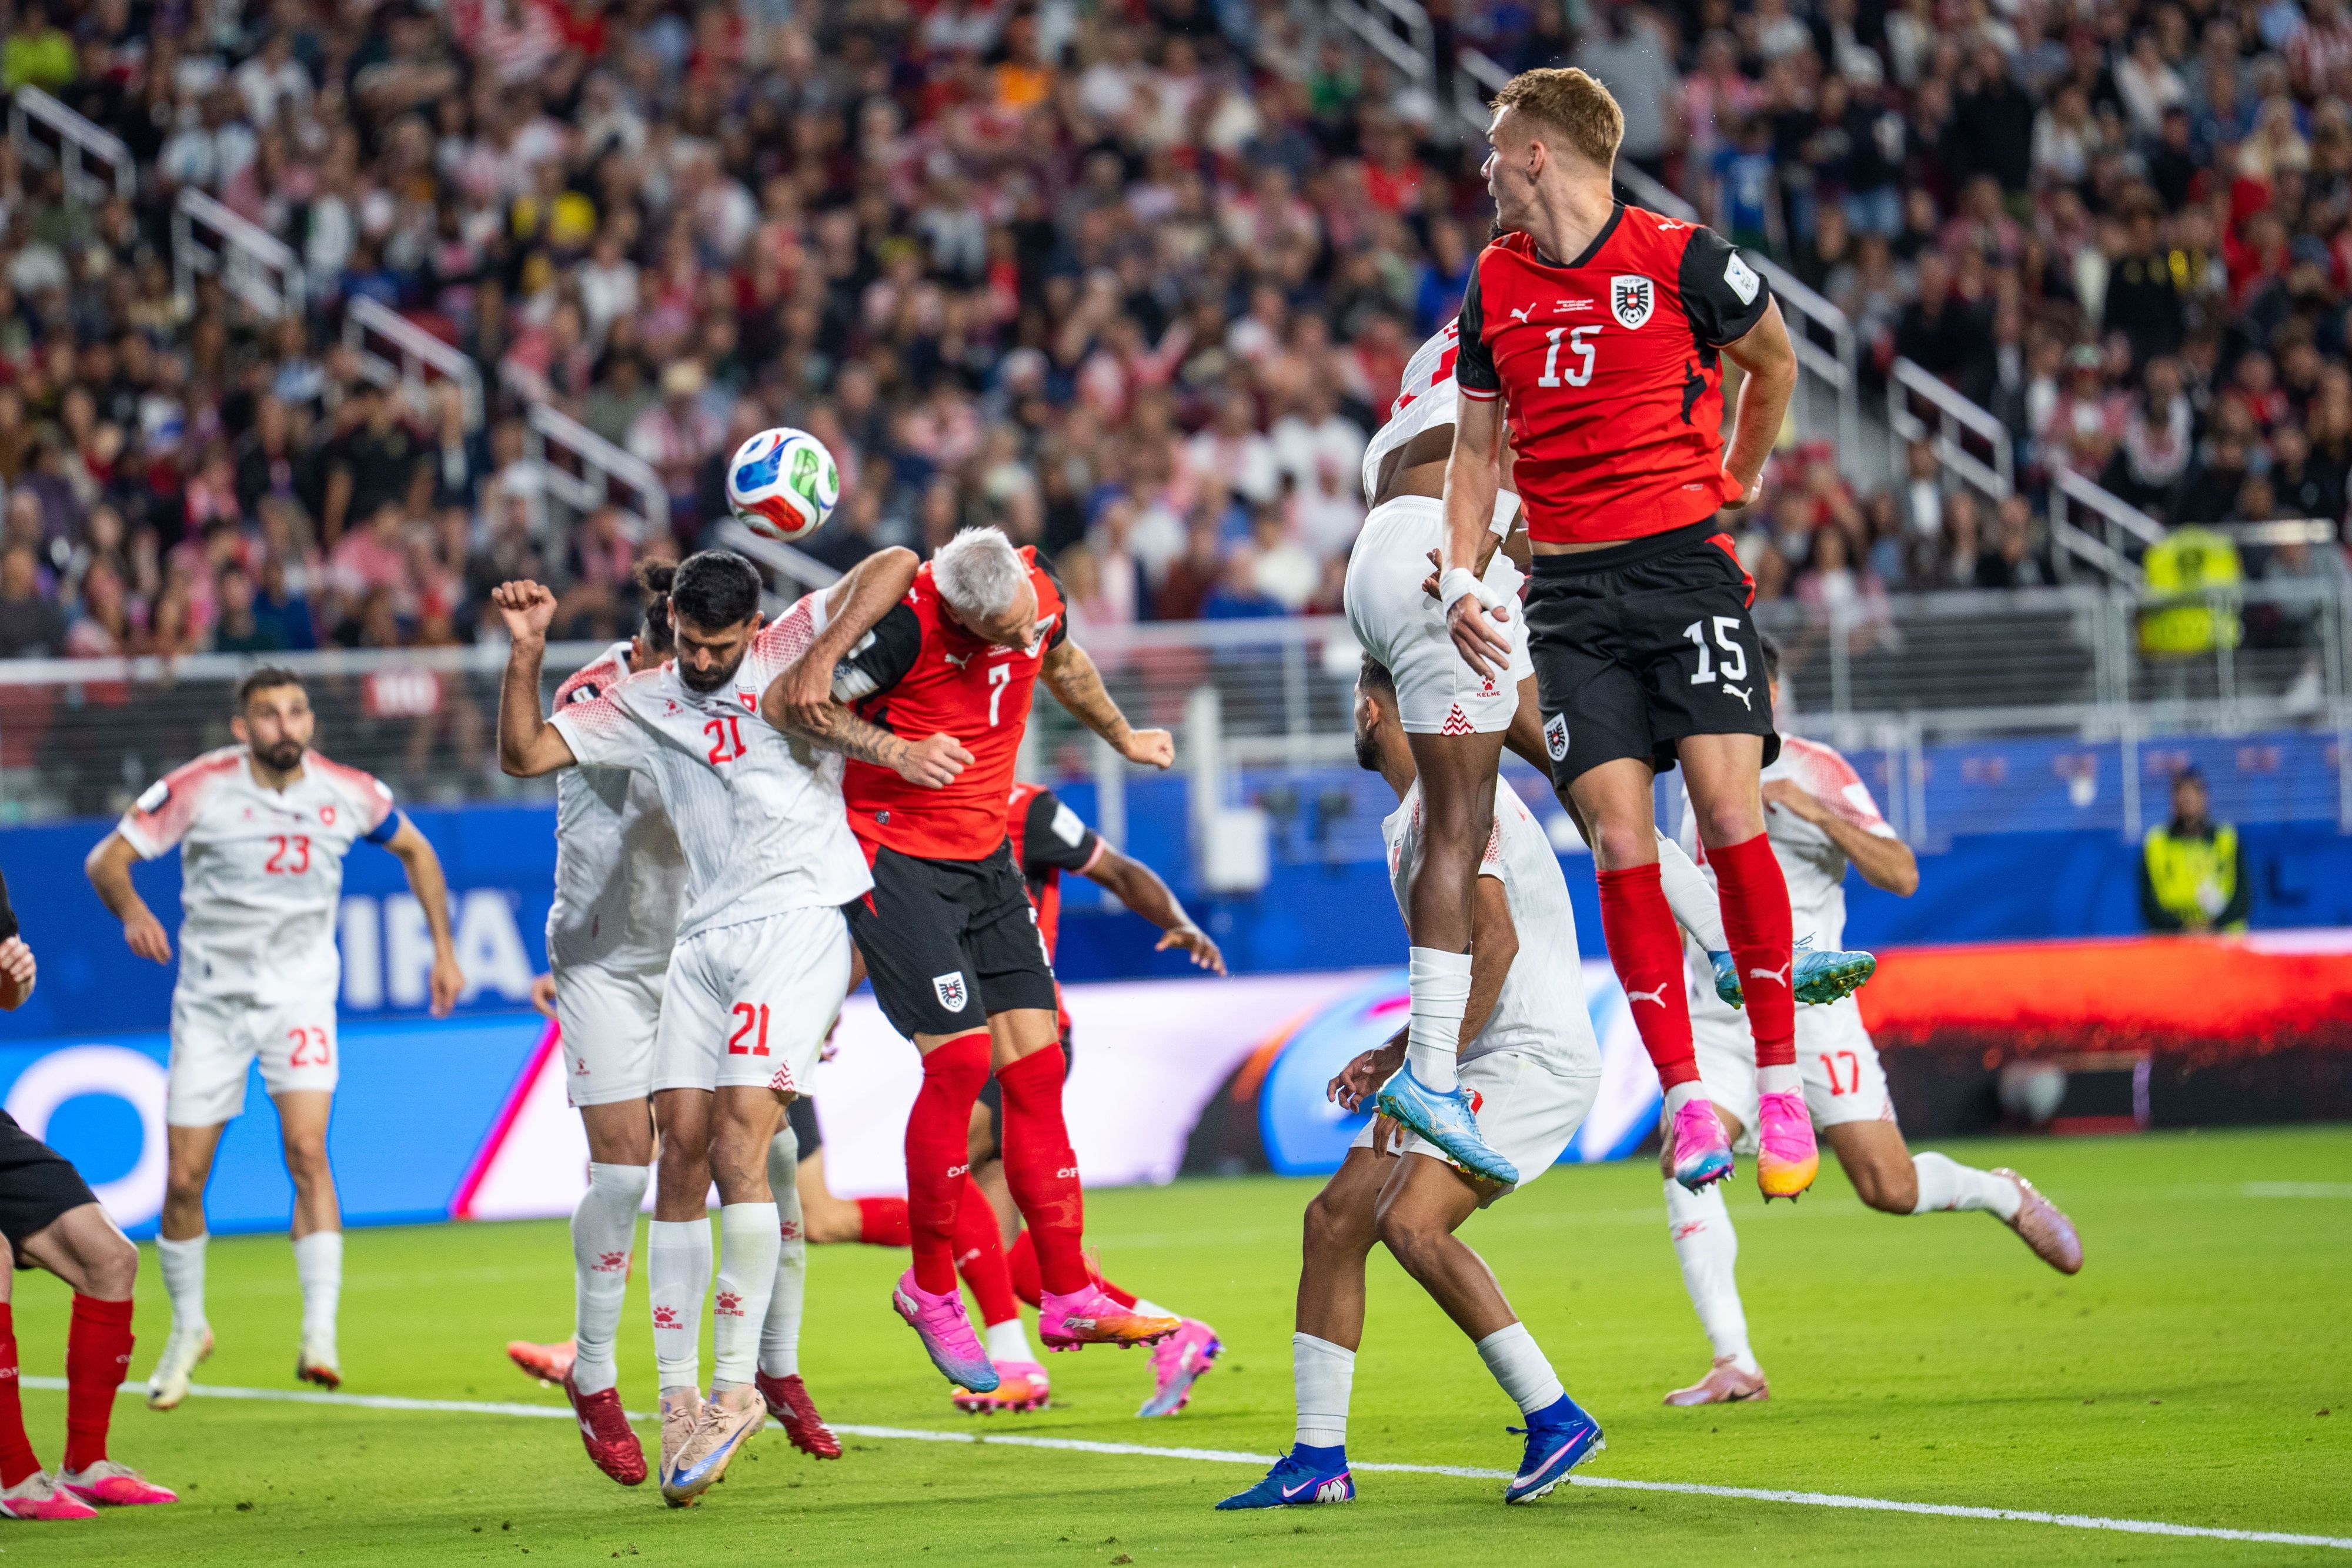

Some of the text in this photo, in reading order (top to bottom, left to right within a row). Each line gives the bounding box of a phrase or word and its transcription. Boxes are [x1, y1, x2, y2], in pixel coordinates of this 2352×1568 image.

[1538, 325, 1604, 387] 15
[1682, 616, 1747, 685] 15
[989, 663, 1011, 727] 7
[704, 716, 747, 765] 21
[265, 834, 310, 875] 23
[338, 888, 532, 1008] IFA
[287, 1027, 330, 1067] 23
[729, 1002, 770, 1057] 21
[1819, 1049, 1860, 1096] 17
